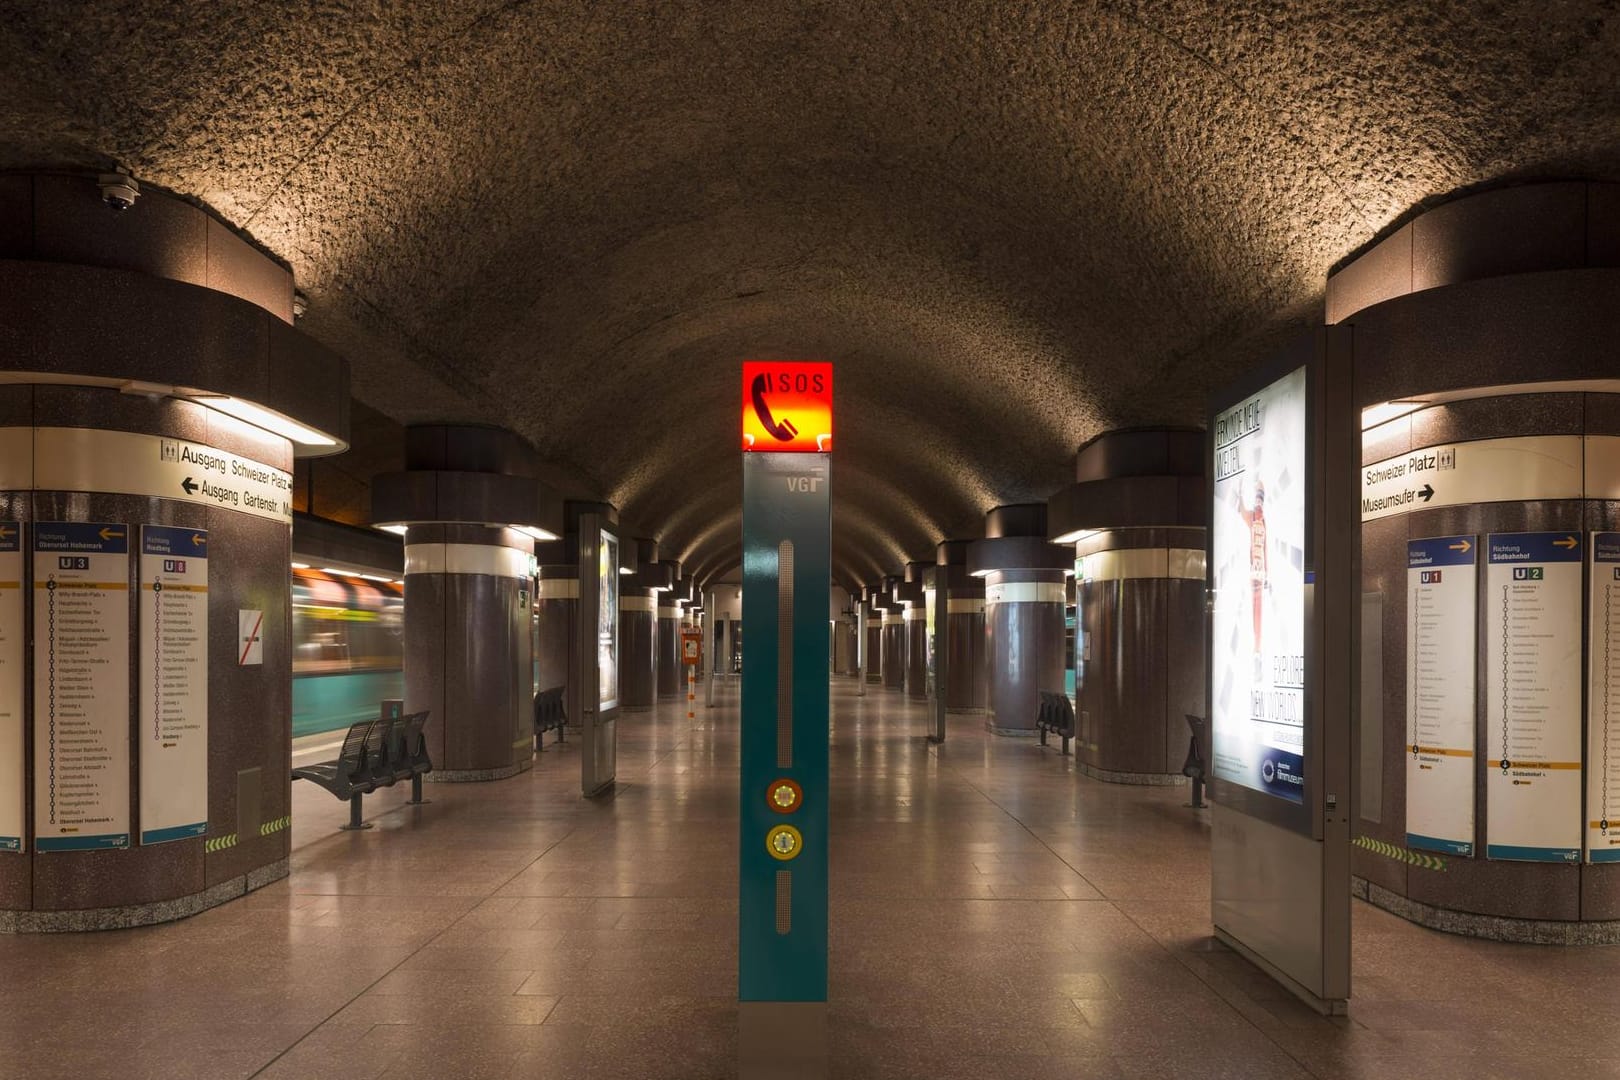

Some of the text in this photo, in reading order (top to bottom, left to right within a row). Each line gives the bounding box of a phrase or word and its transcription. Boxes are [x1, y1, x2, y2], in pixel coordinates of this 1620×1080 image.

[779, 373, 824, 393] SOS
[1216, 399, 1261, 447] ERKUNDE NEUE
[181, 446, 288, 490] Ausgang Schweizer Platz
[1366, 454, 1436, 486] Schweizer Platz
[201, 480, 239, 506] Ausgang
[243, 491, 279, 513] Gartenstr.
[1362, 488, 1417, 513] Museumsufer
[1493, 545, 1521, 553] Richtung
